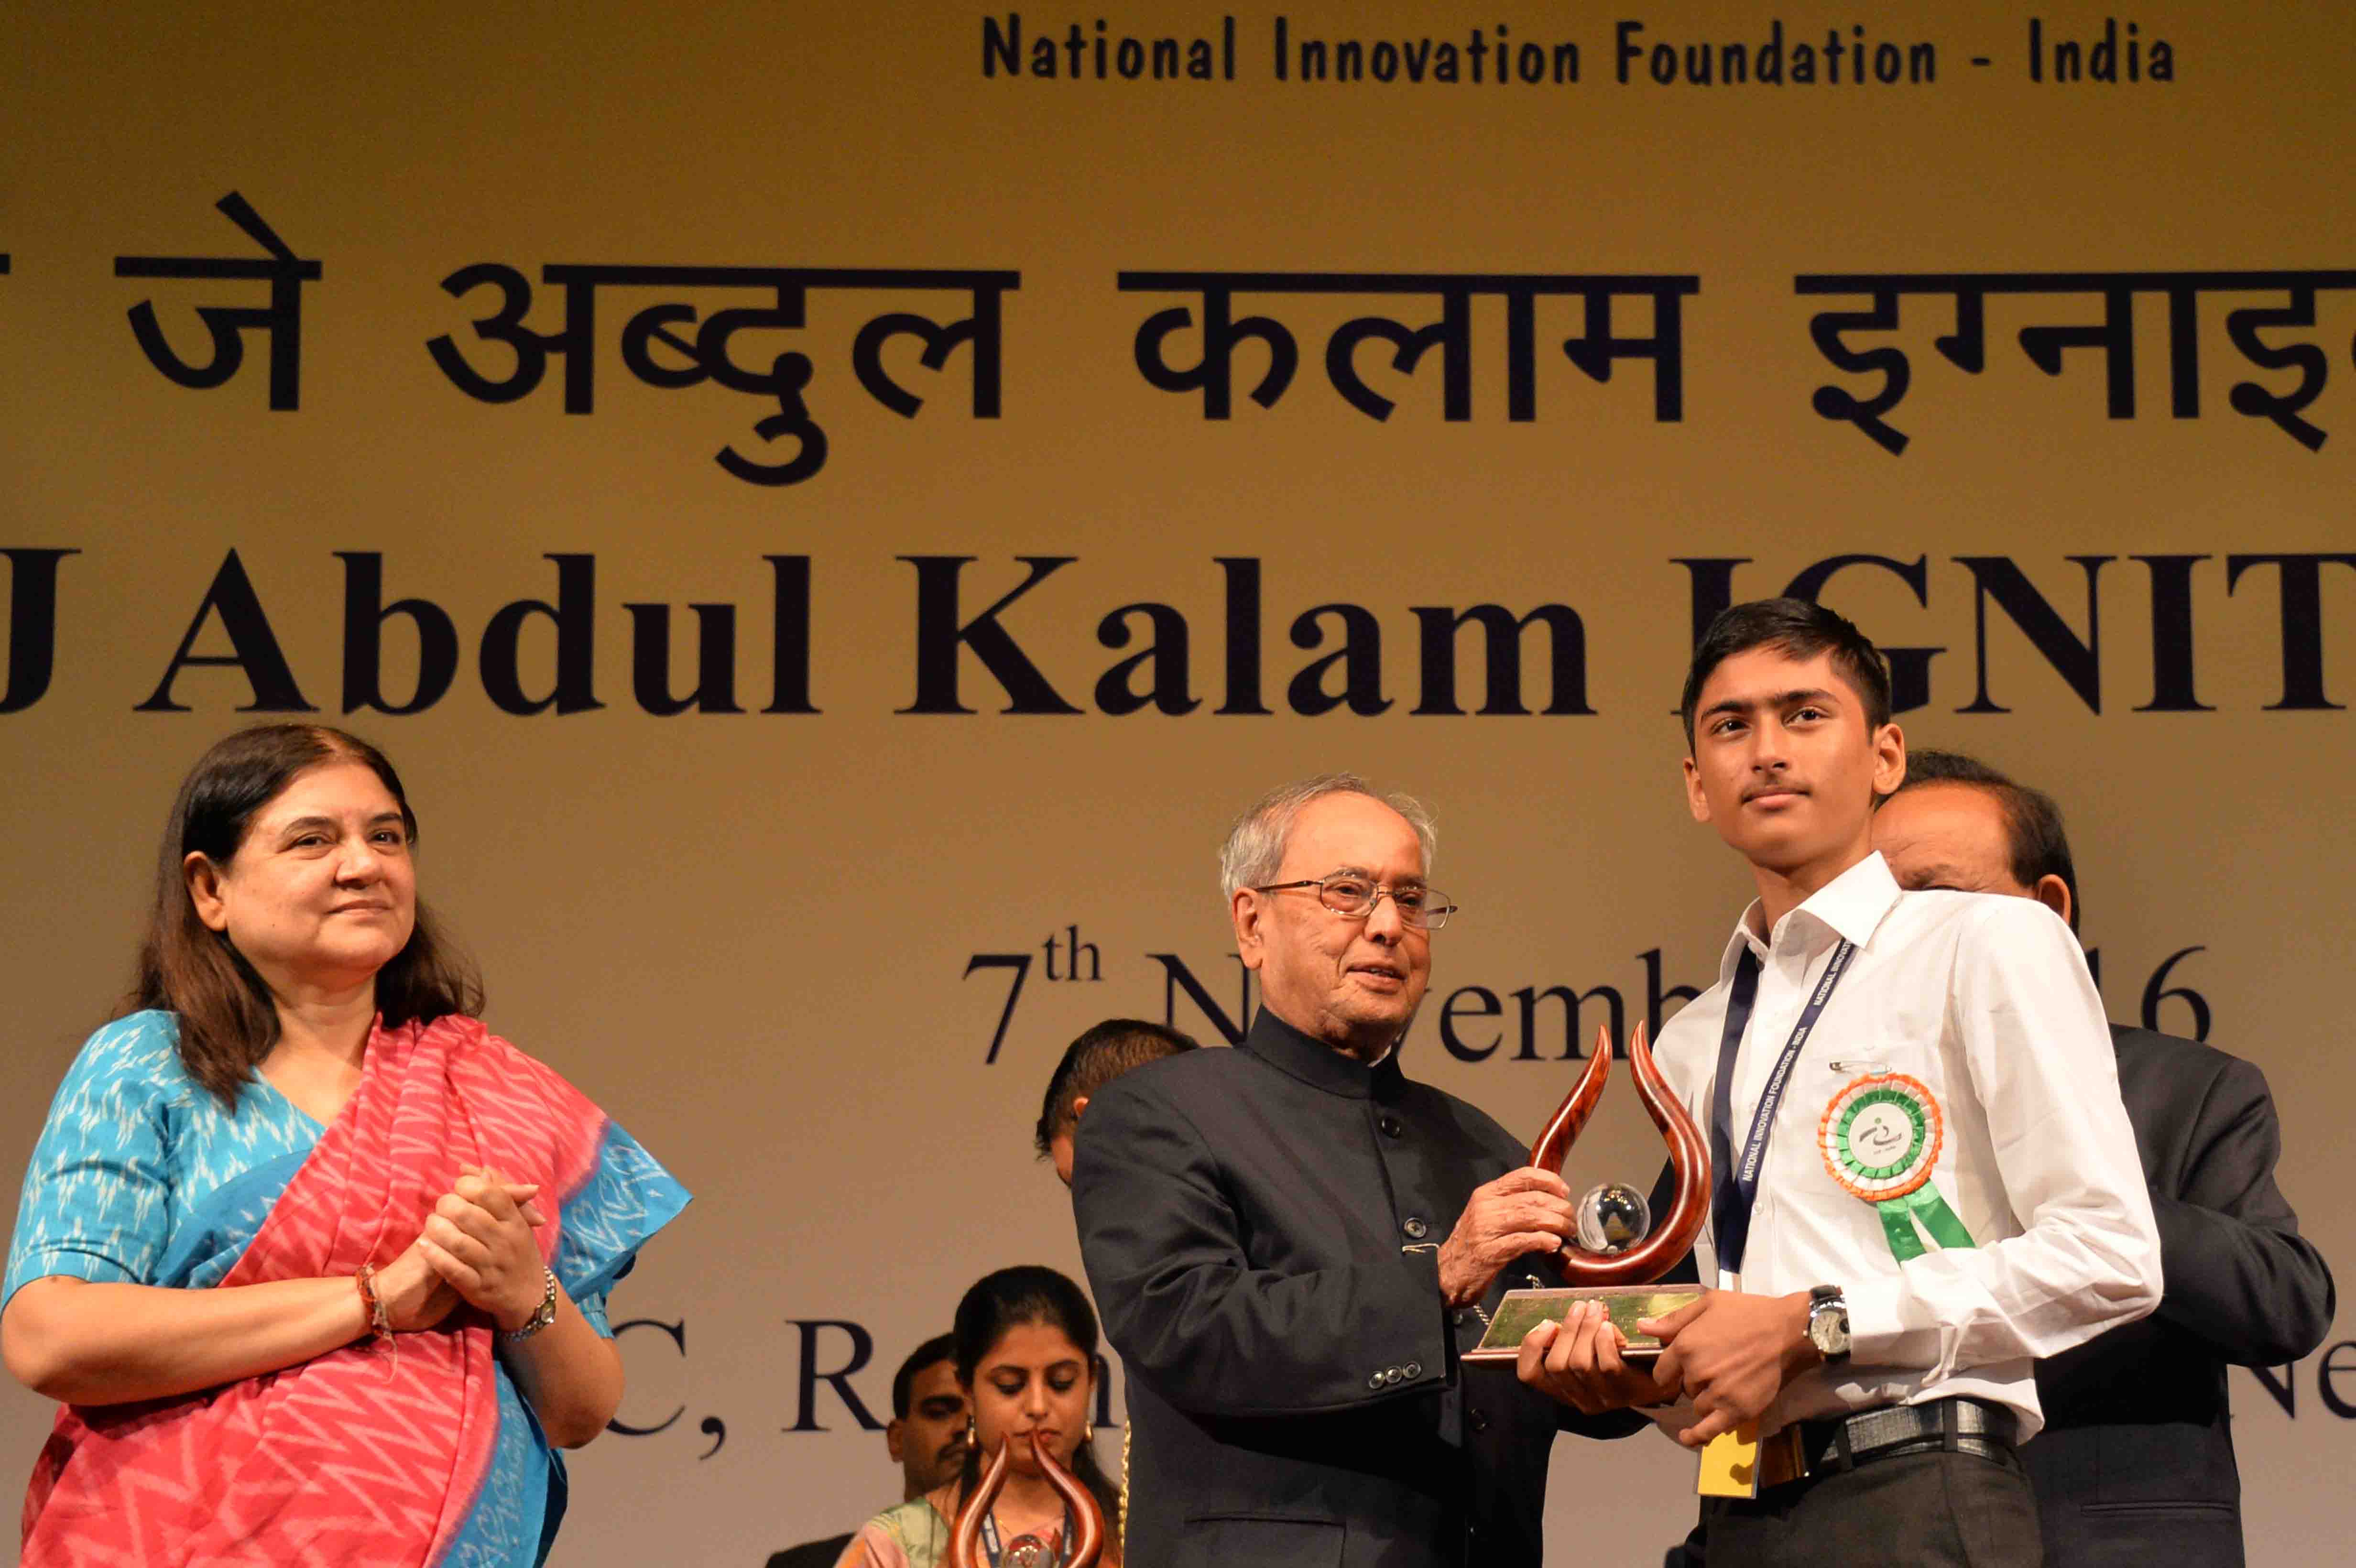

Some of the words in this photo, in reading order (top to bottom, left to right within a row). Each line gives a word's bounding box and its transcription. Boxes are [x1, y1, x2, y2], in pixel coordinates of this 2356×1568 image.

[983, 12, 1235, 81] National
[1275, 16, 1580, 85] Innovation
[1615, 20, 1936, 87] Foundation
[1971, 57, 1992, 66] -
[2029, 17, 2174, 84] India
[113, 189, 323, 411] जे
[425, 262, 1021, 487] अब्दुल
[1117, 271, 1700, 422] कलाम
[1794, 269, 2356, 456] इग्नाइ
[133, 548, 821, 717] Abdul
[894, 555, 1597, 717] Kalam
[963, 925, 1100, 1064] 7th
[1813, 972, 1837, 1005] NATIONAL
[1743, 1142, 1761, 1182] NATIONAL
[1754, 1095, 1775, 1142] INNOVATION
[1769, 1050, 1795, 1094] FOUNDATION
